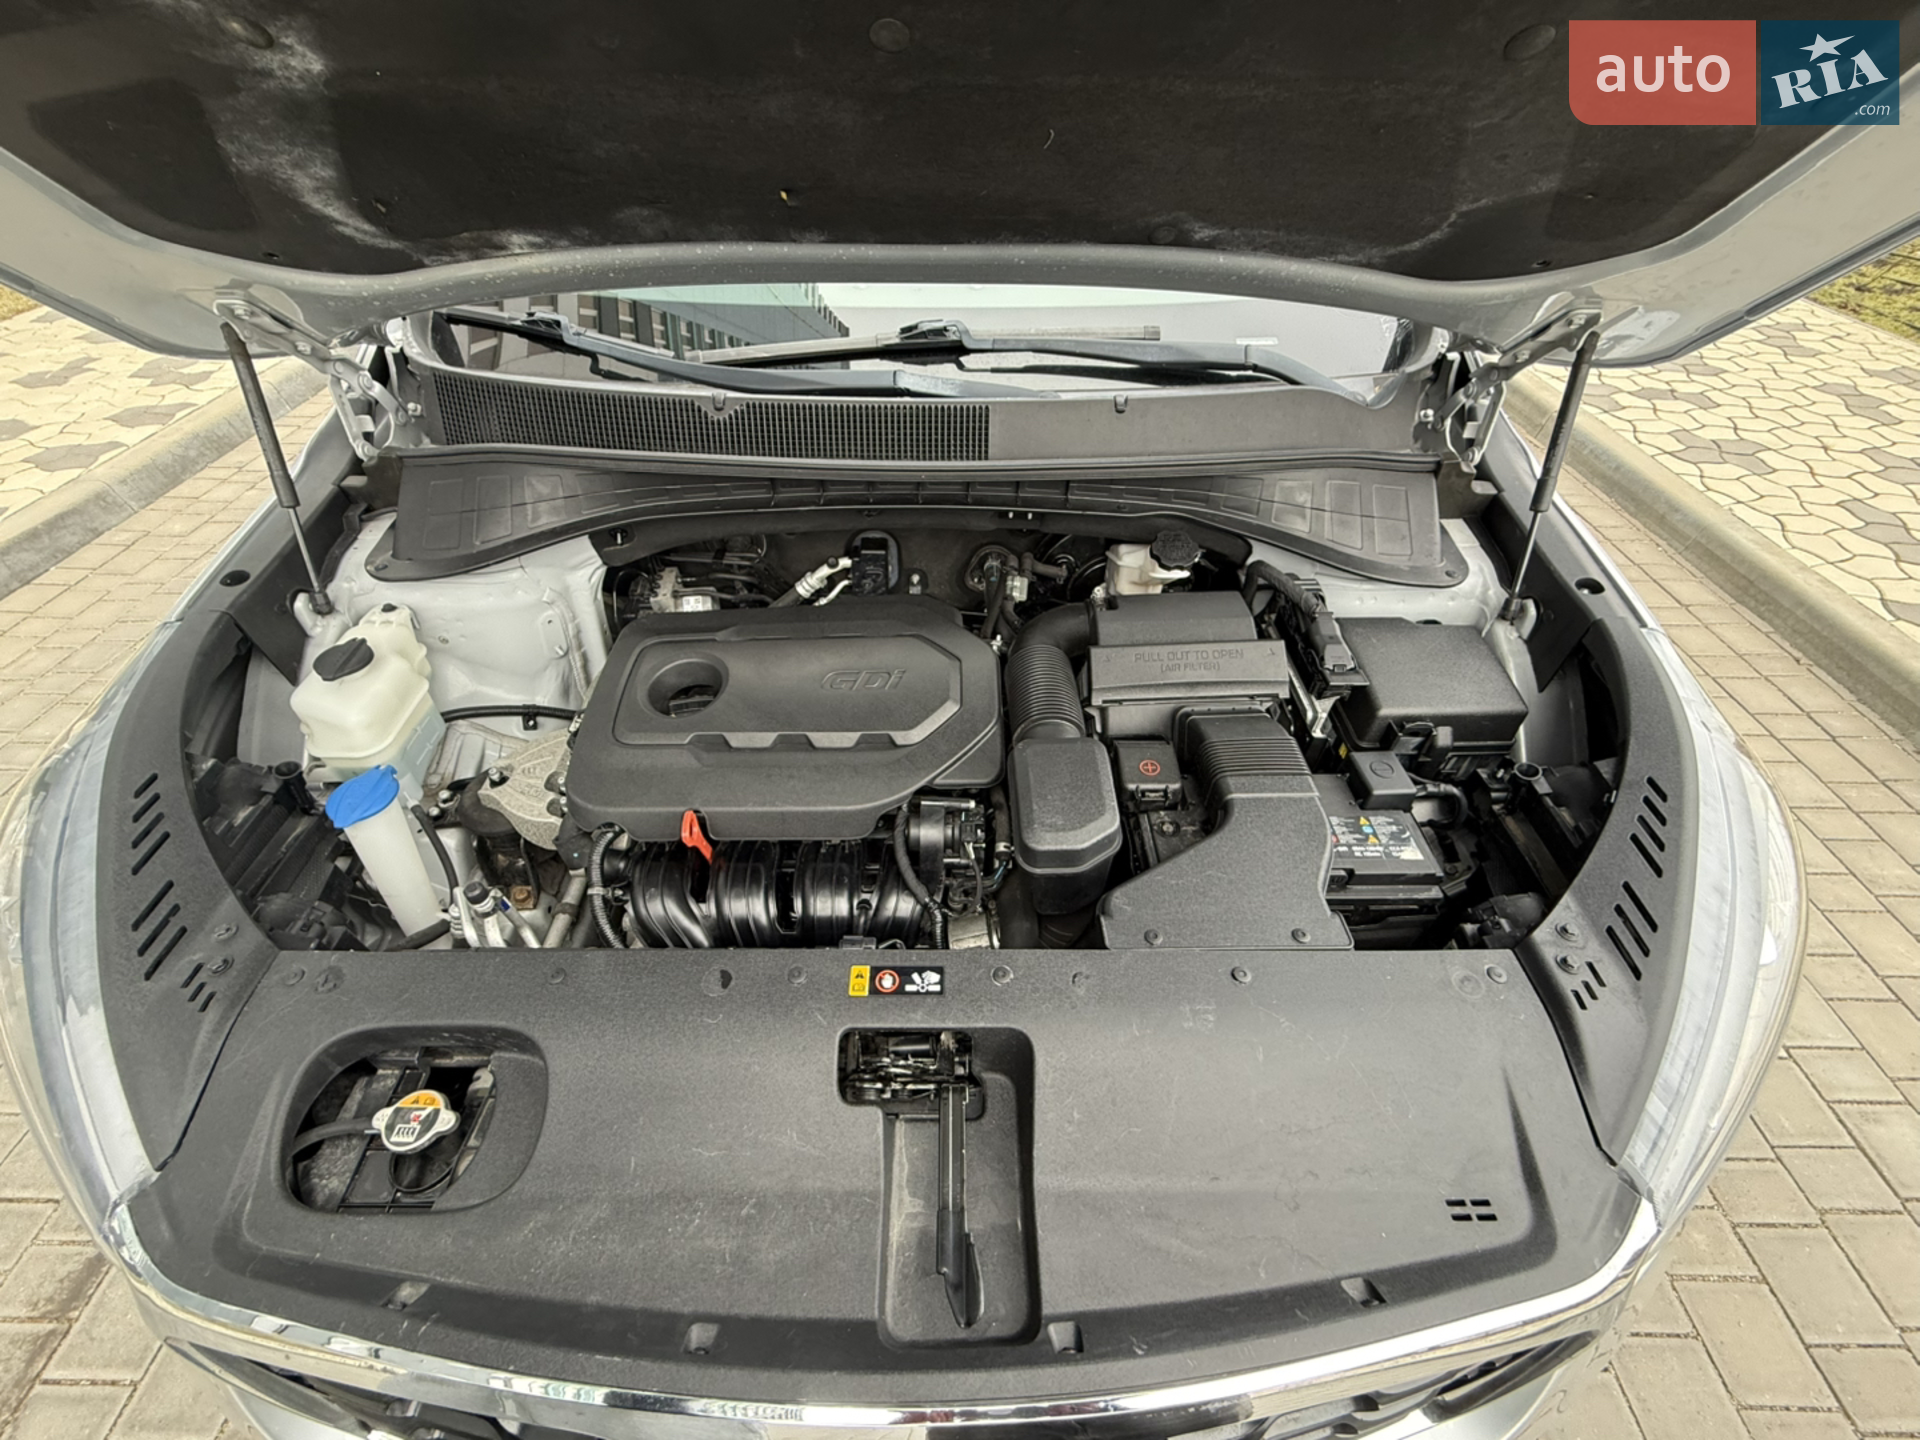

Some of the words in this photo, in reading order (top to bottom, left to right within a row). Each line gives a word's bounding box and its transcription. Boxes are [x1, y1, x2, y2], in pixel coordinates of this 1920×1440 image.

[1134, 652, 1164, 663] PULL
[1167, 650, 1191, 662] OUT
[1192, 649, 1209, 661] TO
[1212, 648, 1244, 660] OPEN
[1160, 663, 1181, 673] (AIR
[1183, 662, 1221, 672] FILTER)
